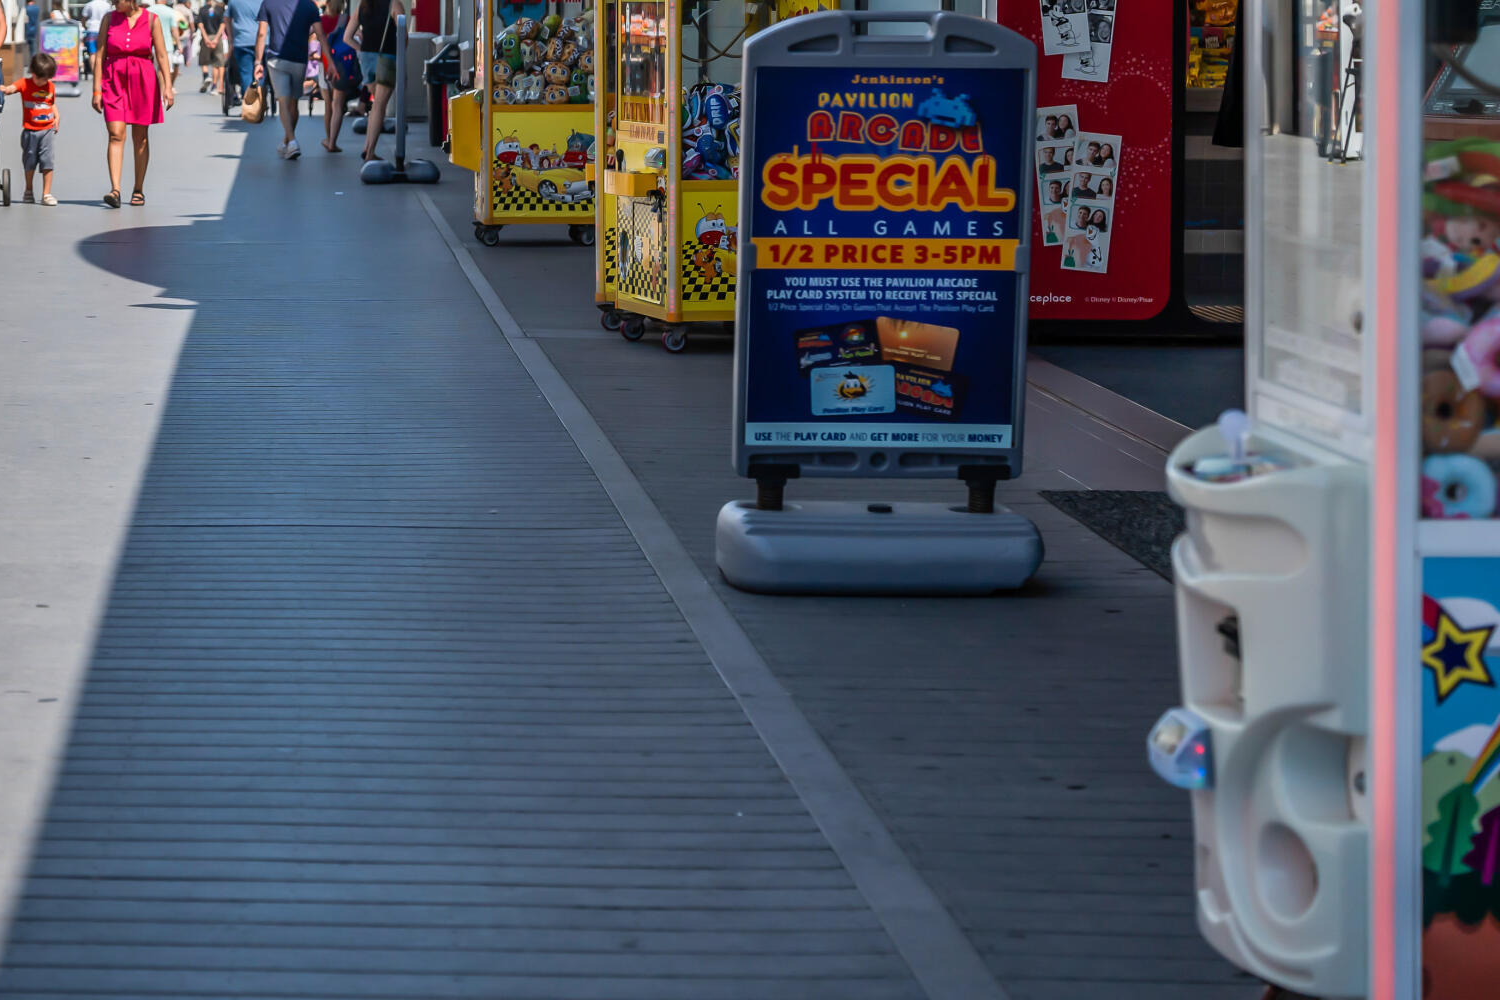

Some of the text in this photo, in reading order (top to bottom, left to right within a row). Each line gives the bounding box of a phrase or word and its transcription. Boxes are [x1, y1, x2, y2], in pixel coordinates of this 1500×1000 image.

[851, 73, 945, 85] Jenkinson's
[818, 92, 914, 108] PAVILION
[710, 97, 723, 126] DRIP
[806, 110, 984, 153] ARCADE
[763, 155, 1015, 211] SPECIAL
[773, 220, 1004, 236] ALL GAMES
[769, 244, 1002, 266] 1/2 PRICE 3-5PM
[784, 277, 979, 288] YOU MUST USE THE PAVILION ARCADE
[766, 289, 998, 301] PLAY CARD SYSTEM TO RECEIVE THIS SPECIAL
[1029, 292, 1072, 305] ceplace
[754, 432, 1003, 443] USE THE PLAY CARD AND GET MORE FOR YOUR MONEY
